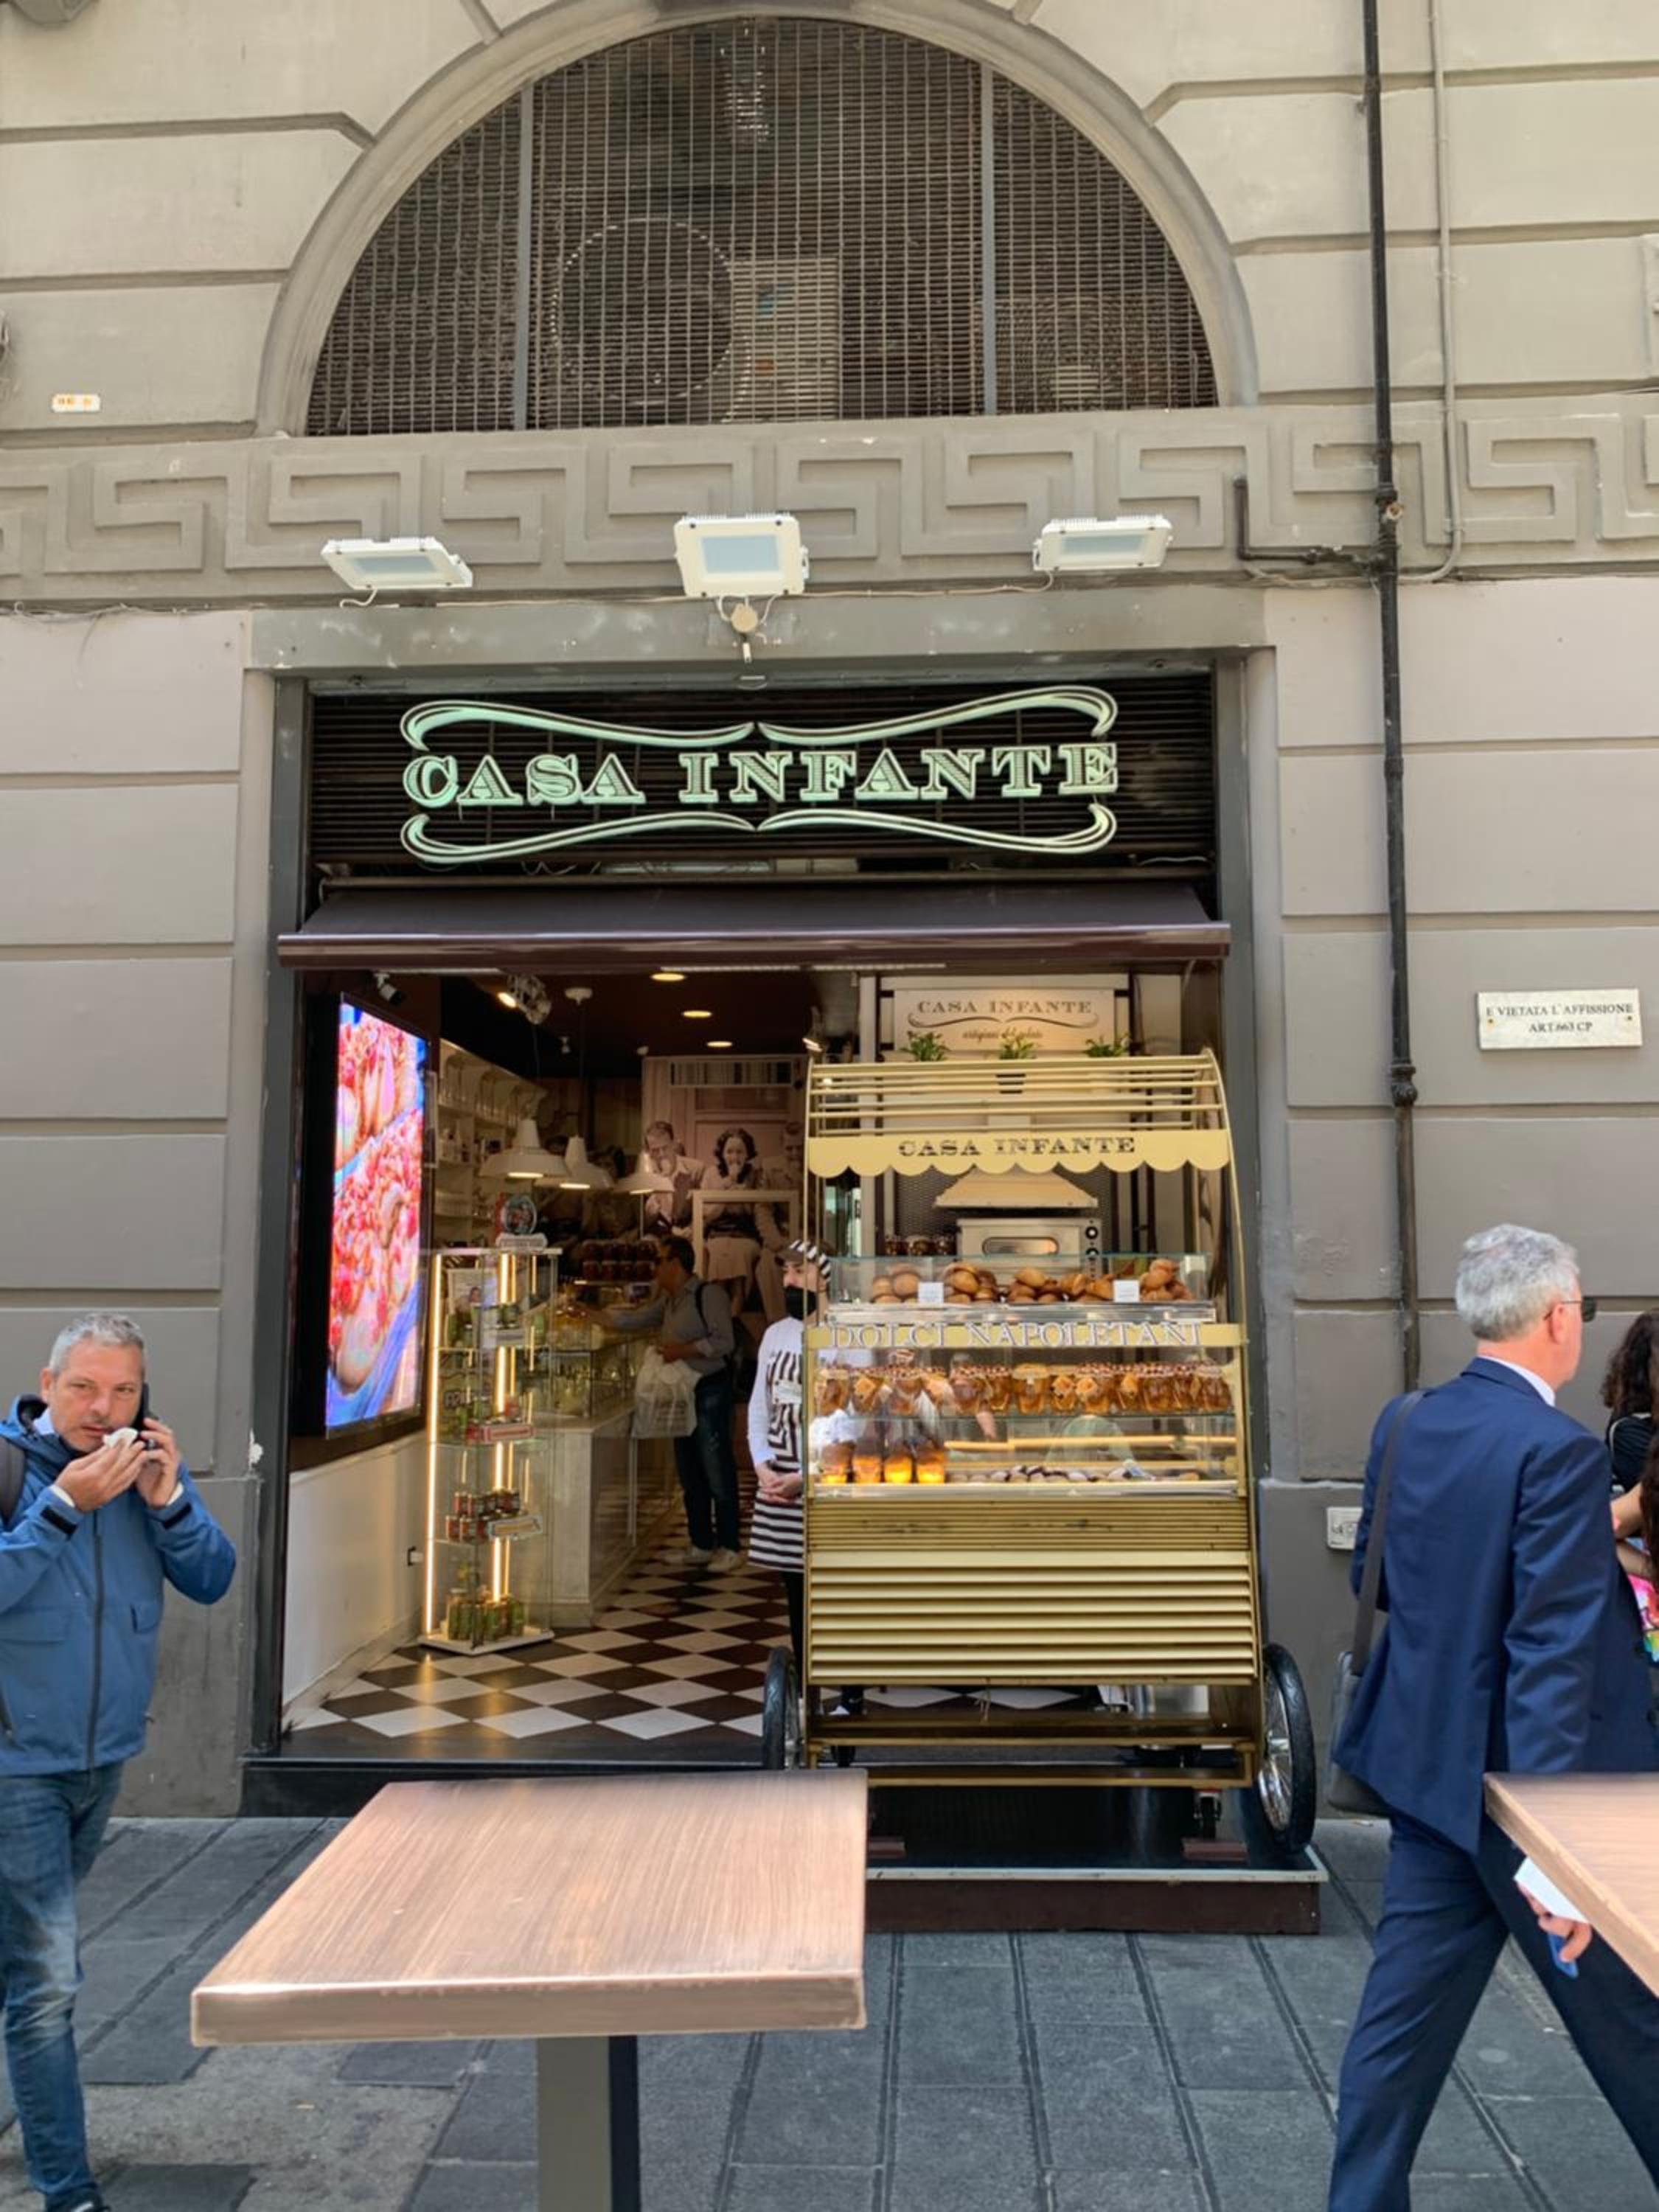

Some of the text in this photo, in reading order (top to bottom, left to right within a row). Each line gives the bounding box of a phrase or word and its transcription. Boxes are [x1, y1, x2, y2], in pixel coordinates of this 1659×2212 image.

[402, 742, 1119, 808] CASA INFANTE
[917, 1001, 1093, 1014] CASA INFANTE
[1498, 1005, 1547, 1016] VIETATA
[1576, 1021, 1593, 1032] CP
[897, 1136, 1135, 1157] CASA INFANTE
[830, 1321, 1202, 1348] DOLCI NAPOLETANI
